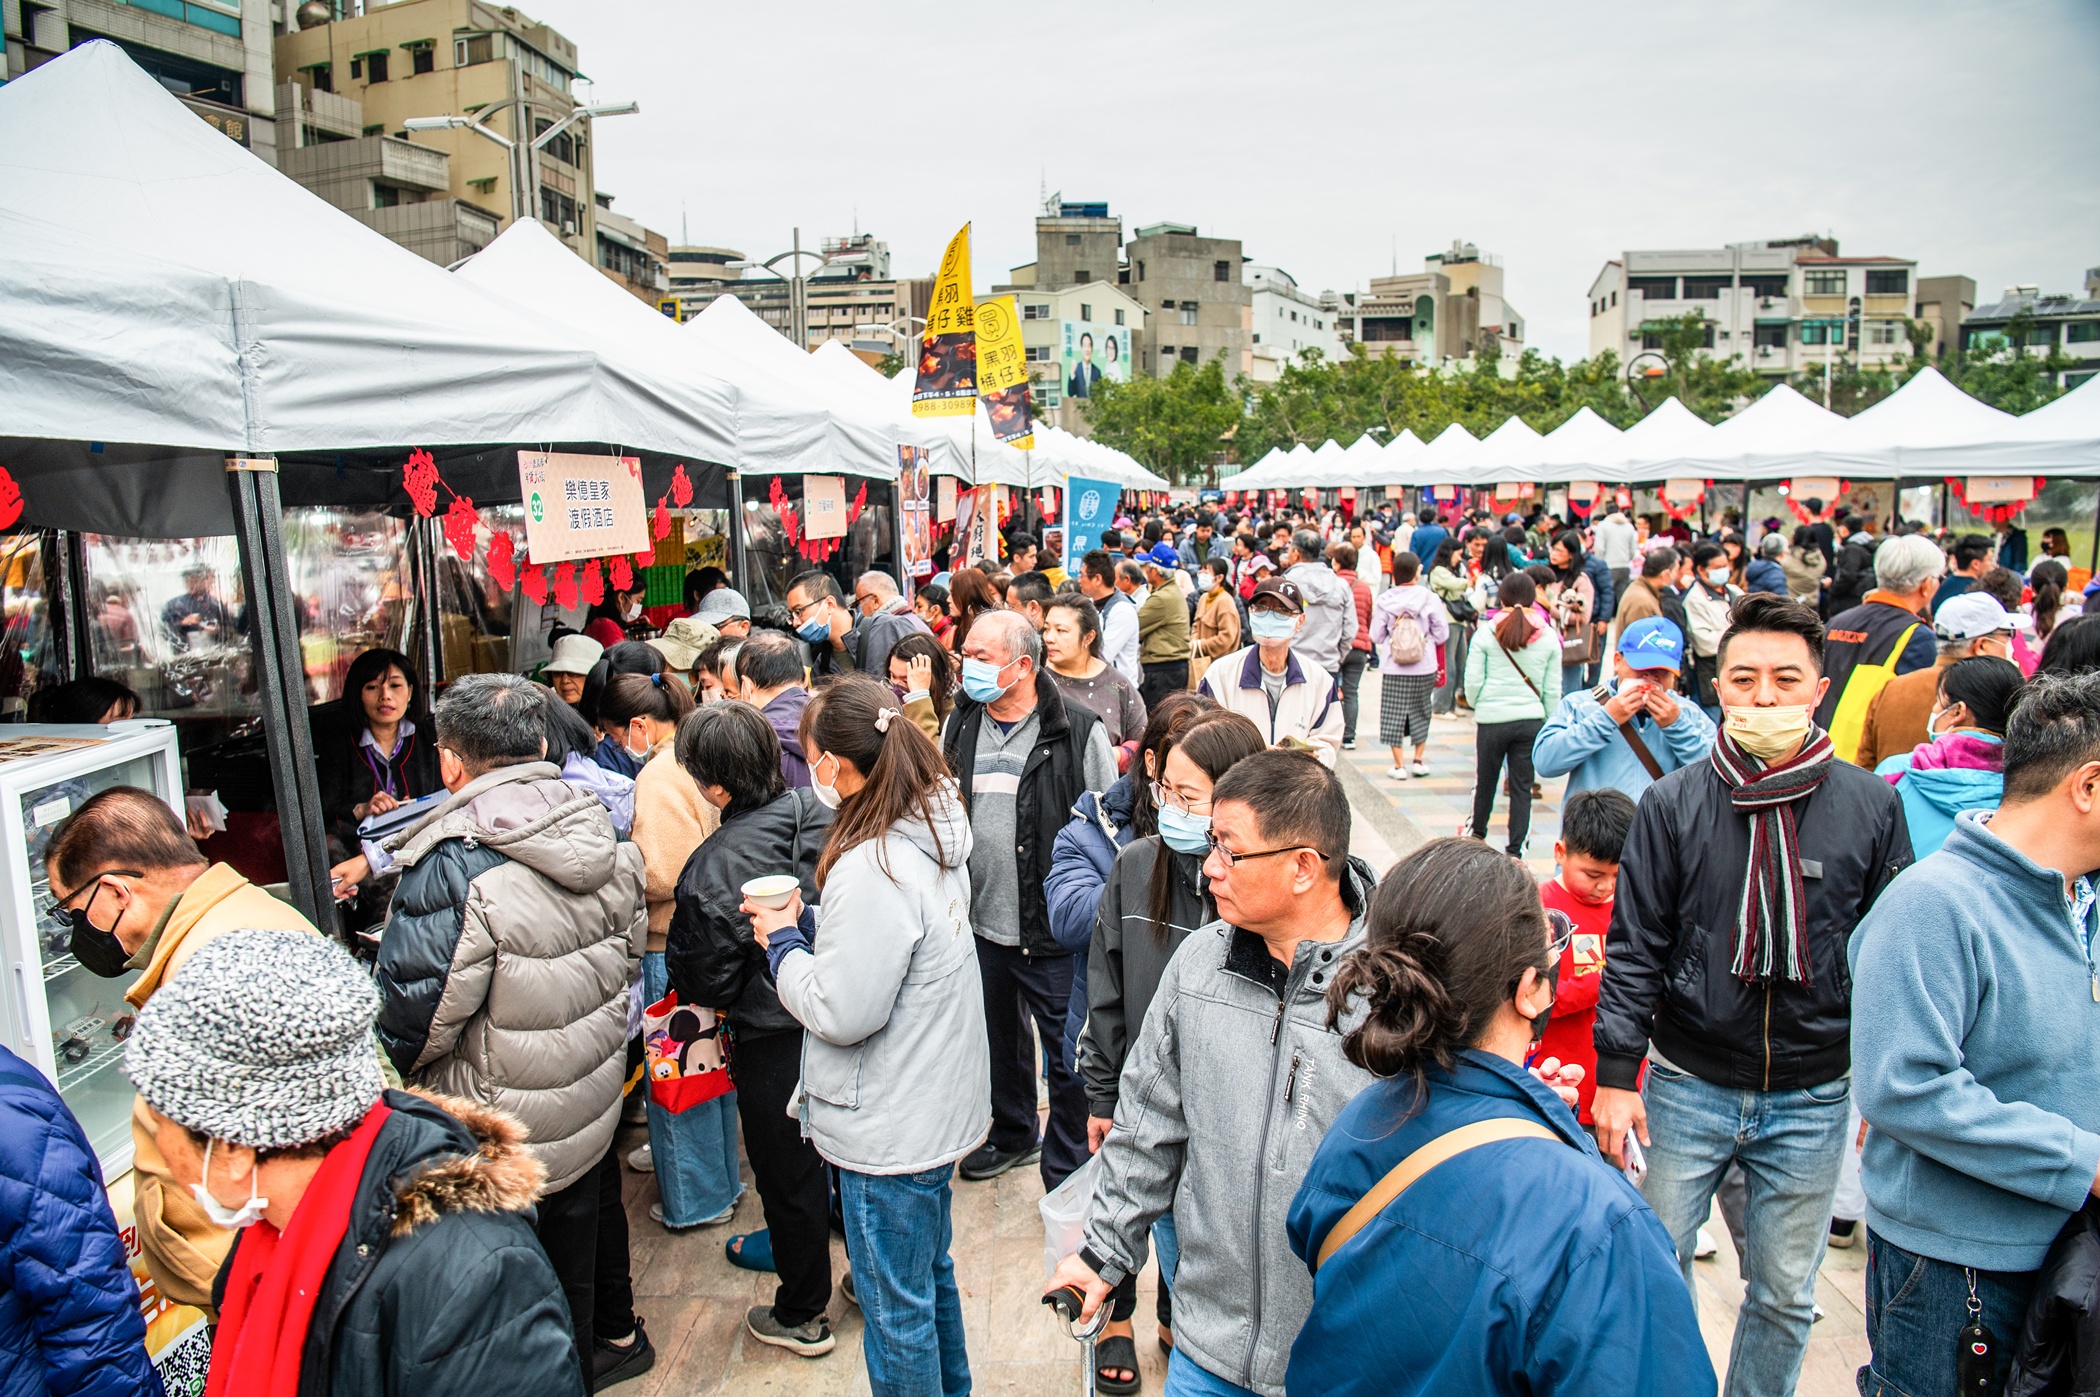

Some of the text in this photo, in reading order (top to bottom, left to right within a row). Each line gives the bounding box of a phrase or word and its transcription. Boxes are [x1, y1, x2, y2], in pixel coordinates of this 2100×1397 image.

[983, 343, 1018, 369] 黑羽
[565, 479, 611, 501] 樂億皇家
[532, 500, 543, 516] 32
[569, 507, 614, 530] 渡假酒店
[1297, 1058, 1315, 1129] TANK RHINO
